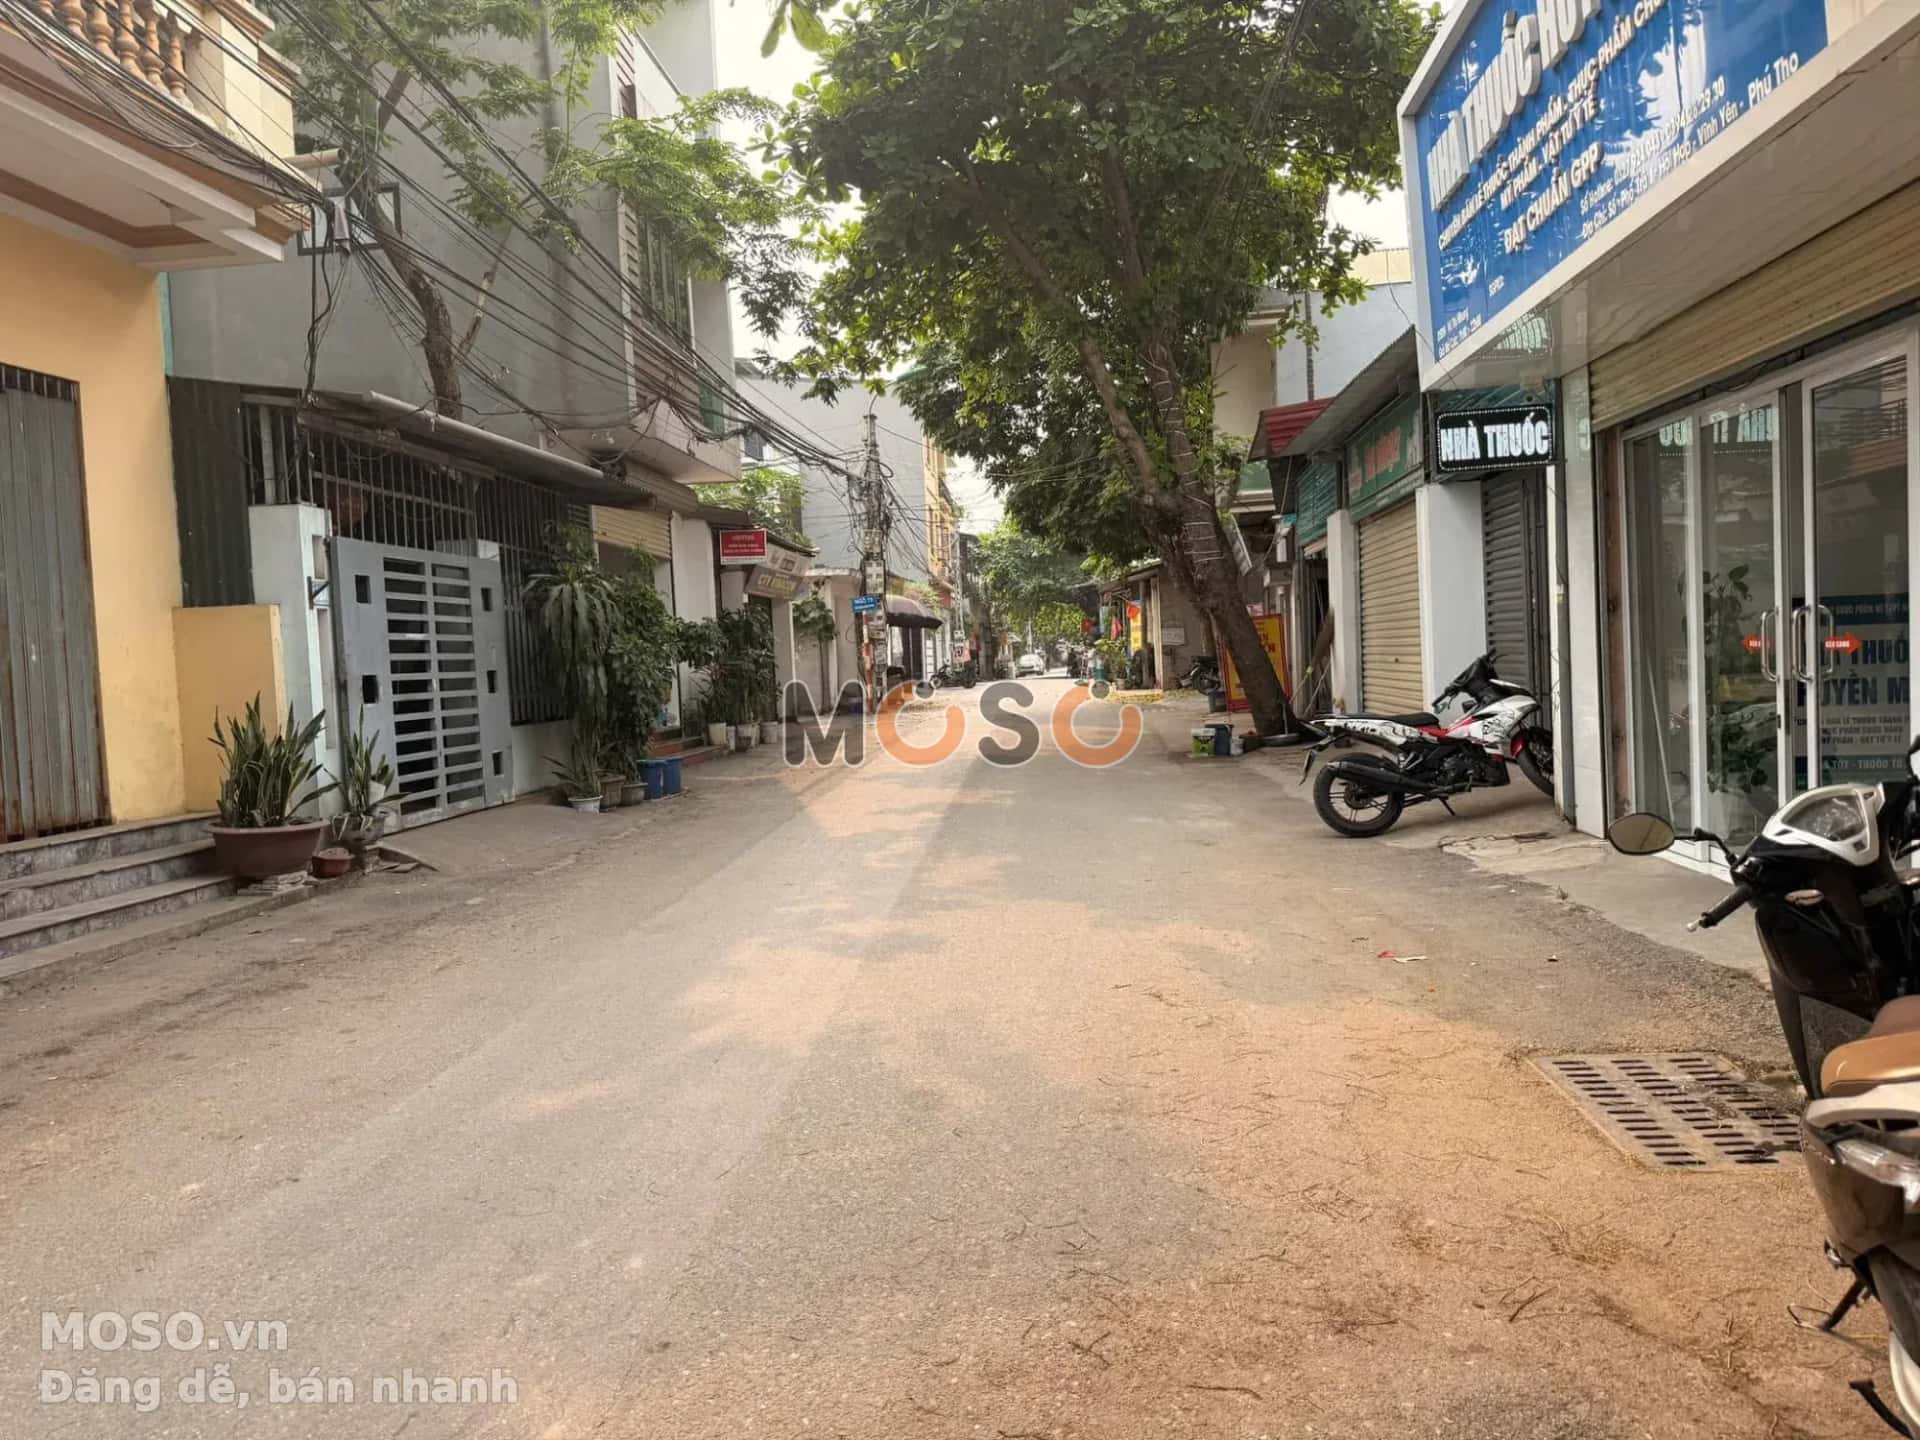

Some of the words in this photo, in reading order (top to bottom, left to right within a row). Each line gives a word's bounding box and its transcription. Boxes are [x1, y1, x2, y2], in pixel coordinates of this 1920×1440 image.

[1598, 14, 1634, 72] PHẨM
[1462, 9, 1542, 166] THUỐC
[1747, 63, 1773, 108] Phú
[1526, 166, 1572, 232] CHUẨN
[1570, 141, 1603, 189] GPP
[1440, 419, 1480, 462] NHÀ
[1483, 411, 1549, 459] THUỐC
